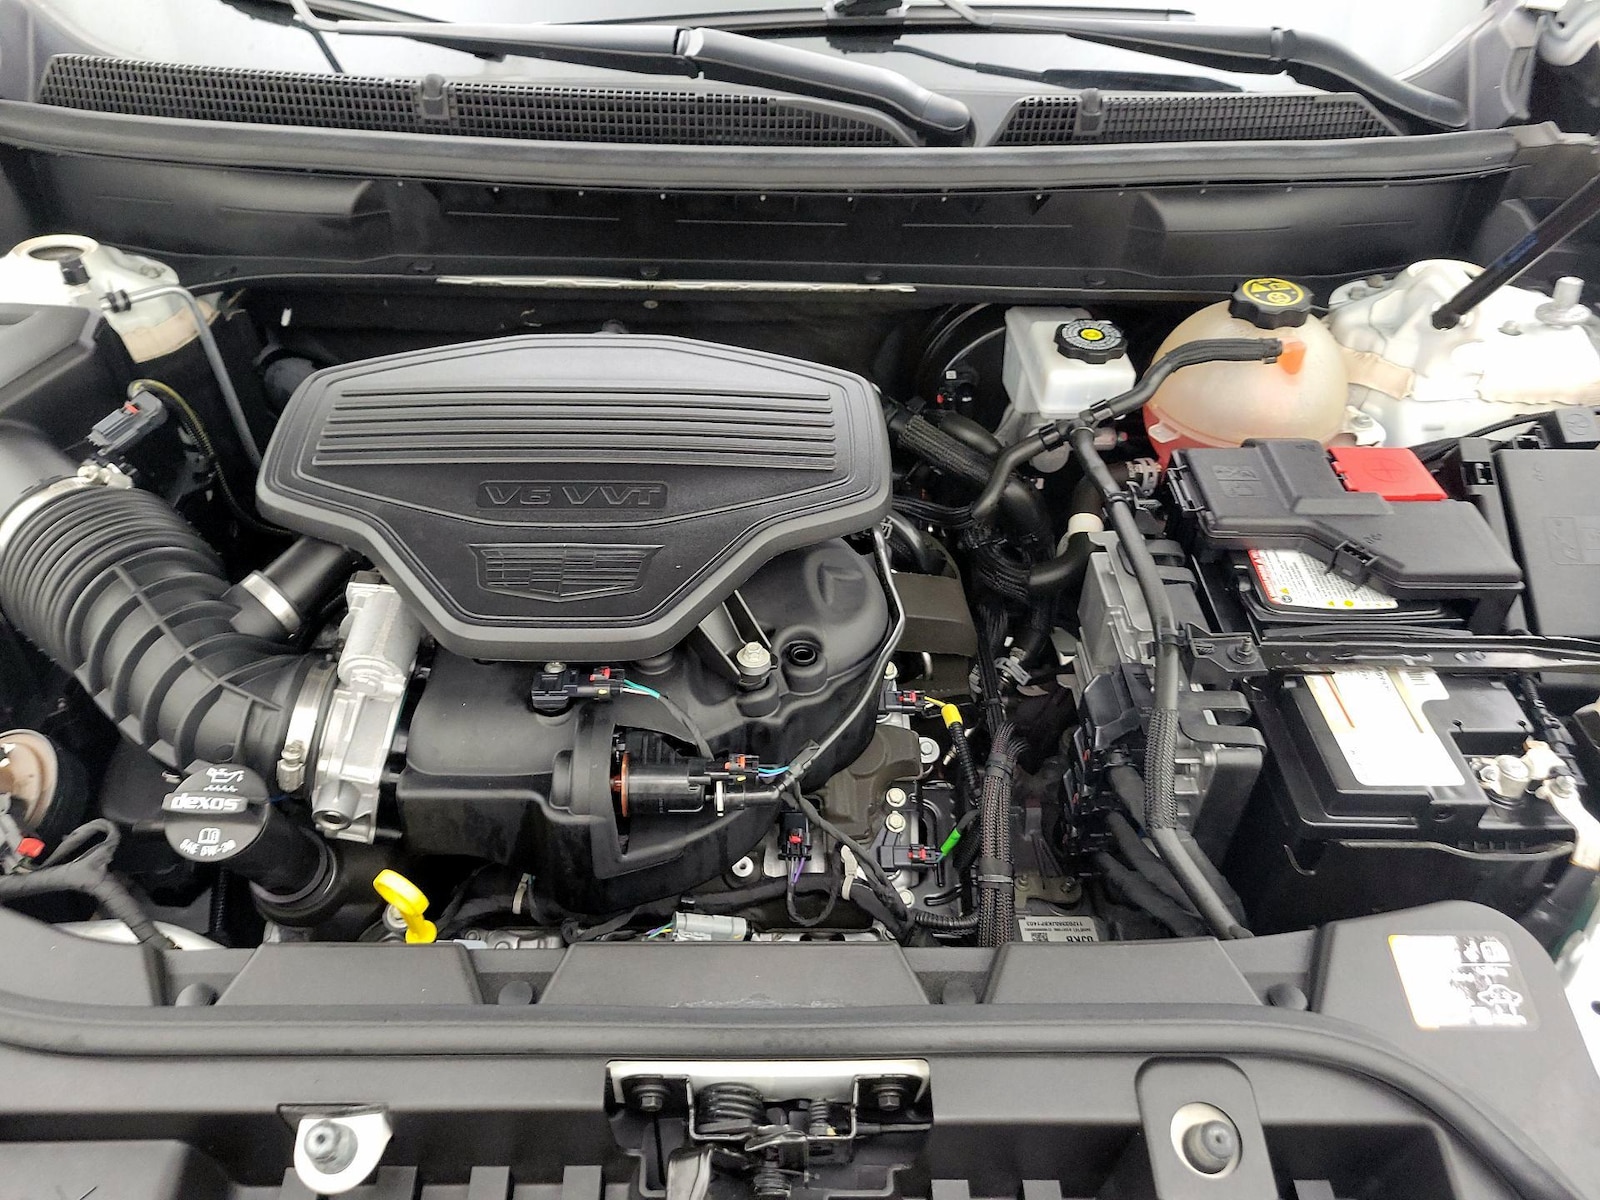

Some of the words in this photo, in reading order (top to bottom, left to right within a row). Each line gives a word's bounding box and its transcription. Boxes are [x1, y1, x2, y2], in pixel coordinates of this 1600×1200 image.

[485, 485, 552, 506] V6
[562, 485, 661, 506] VVT
[171, 793, 241, 811] dexos
